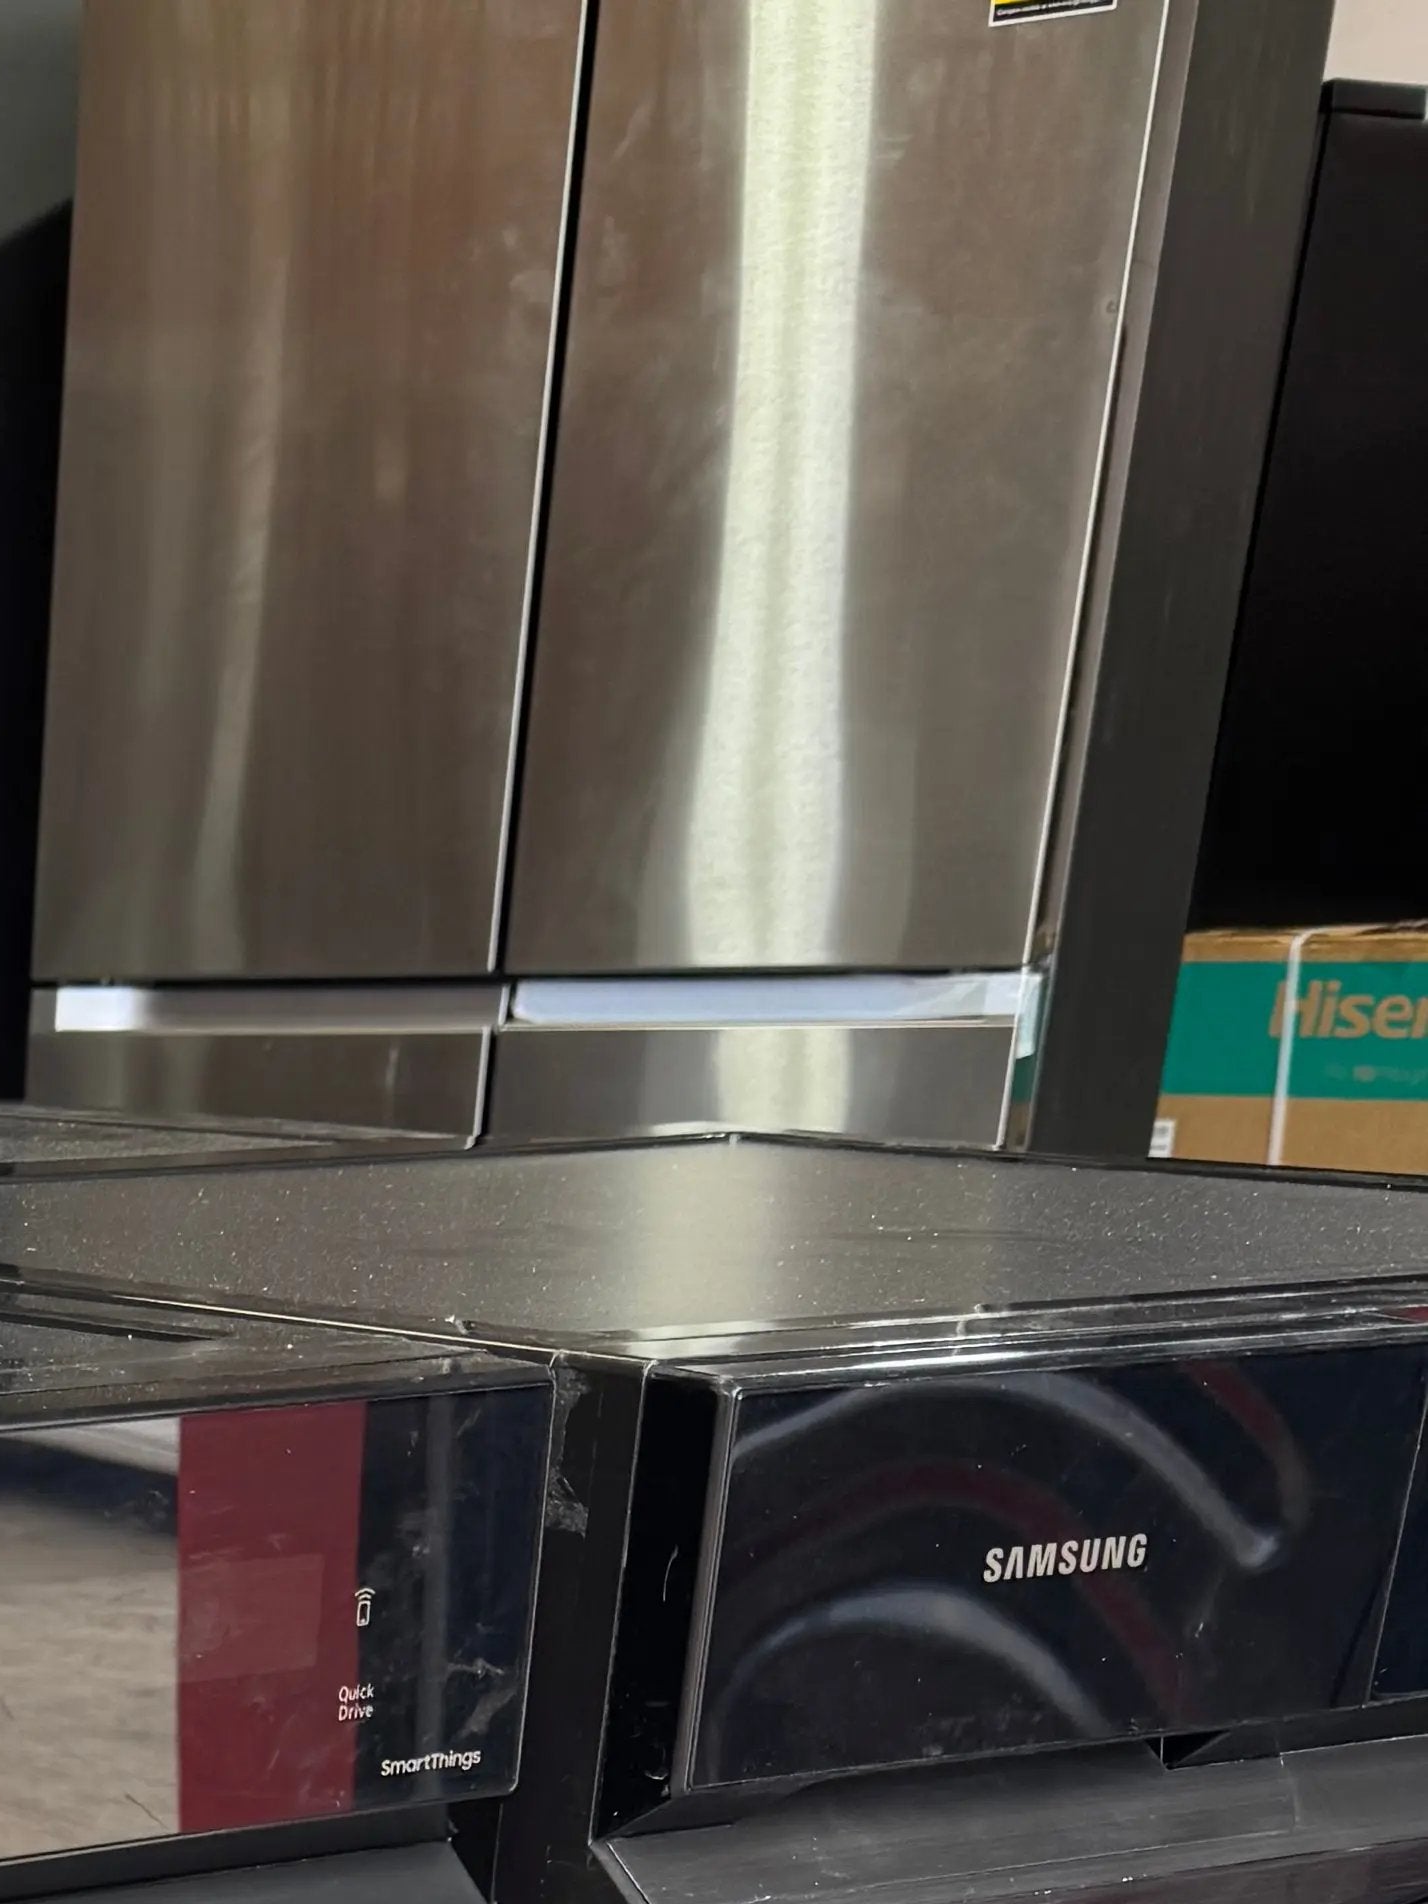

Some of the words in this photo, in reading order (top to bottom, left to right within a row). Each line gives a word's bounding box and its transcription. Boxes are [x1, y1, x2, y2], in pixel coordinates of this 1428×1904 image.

[983, 1533, 1148, 1583] SAMSUNG
[339, 1683, 374, 1703] Quick
[338, 1703, 374, 1721] Drive
[380, 1750, 482, 1777] SmartThings
